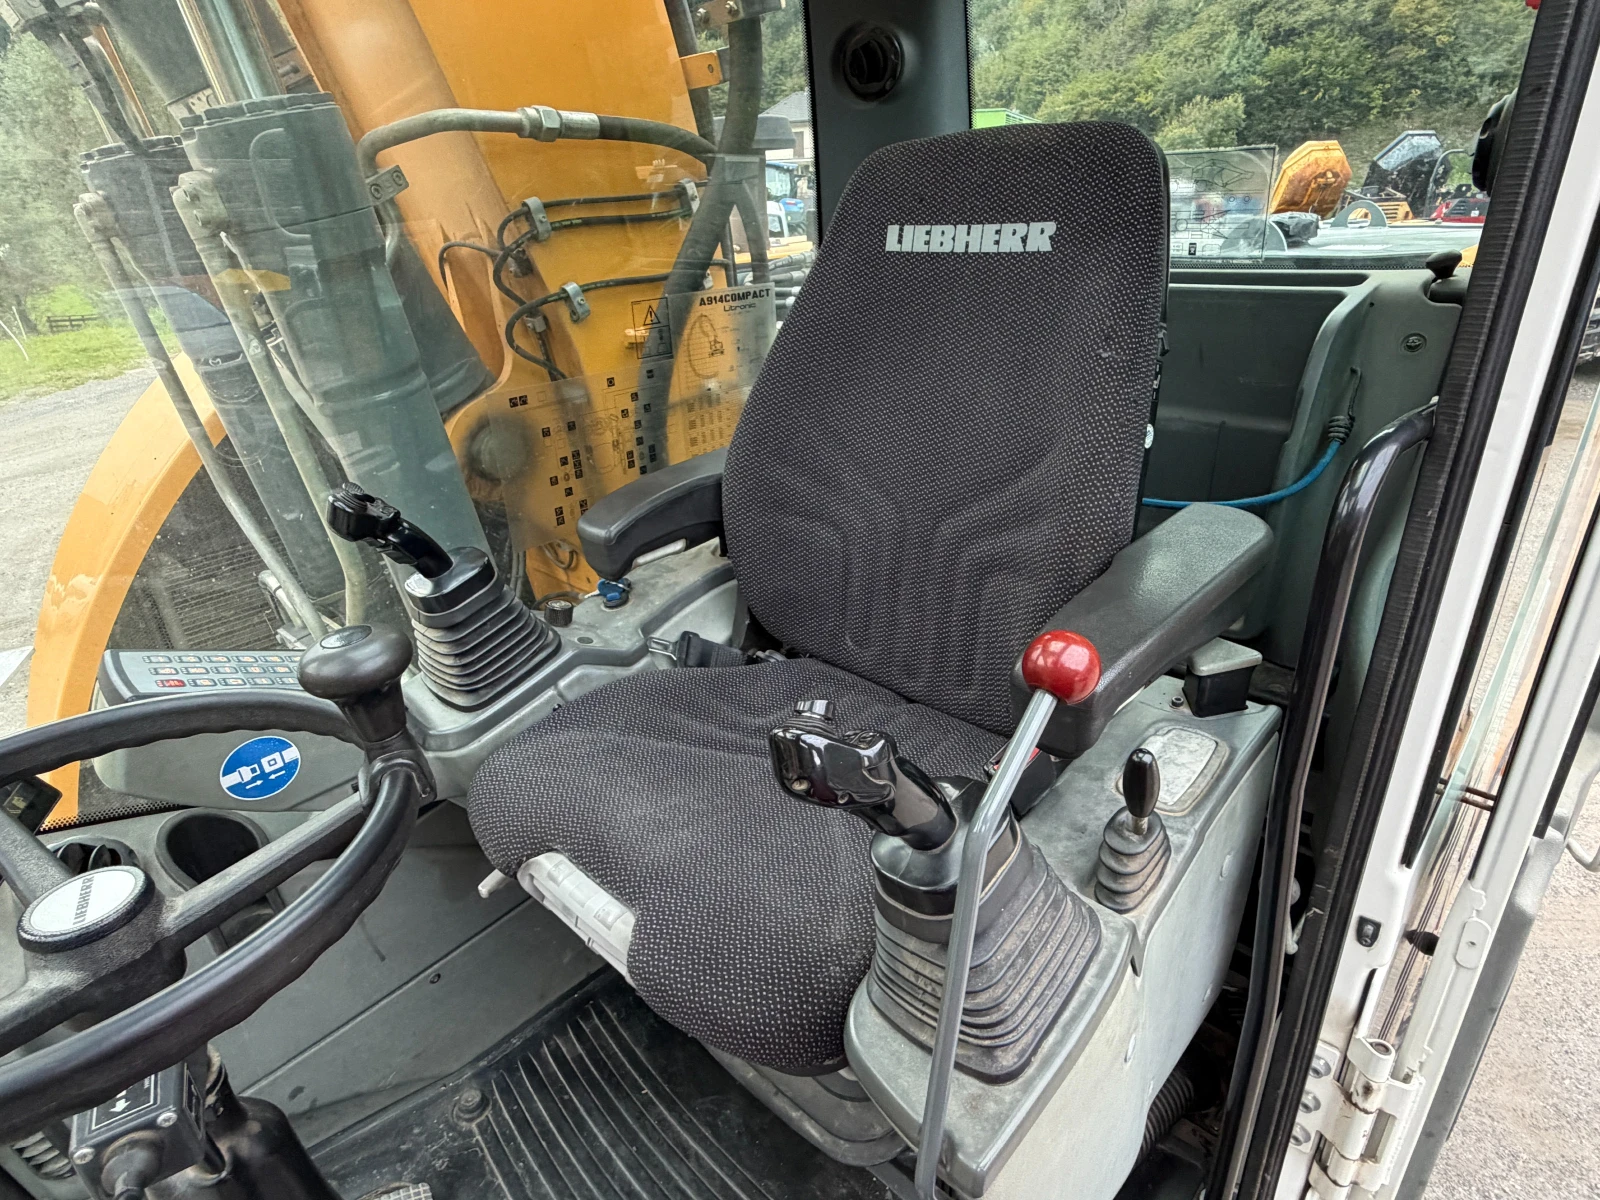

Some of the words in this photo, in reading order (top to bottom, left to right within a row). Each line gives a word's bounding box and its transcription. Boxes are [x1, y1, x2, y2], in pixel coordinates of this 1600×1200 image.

[885, 222, 1057, 253] LIEBHERR
[723, 302, 756, 312] Litronic
[73, 876, 94, 925] LIEBHERR
